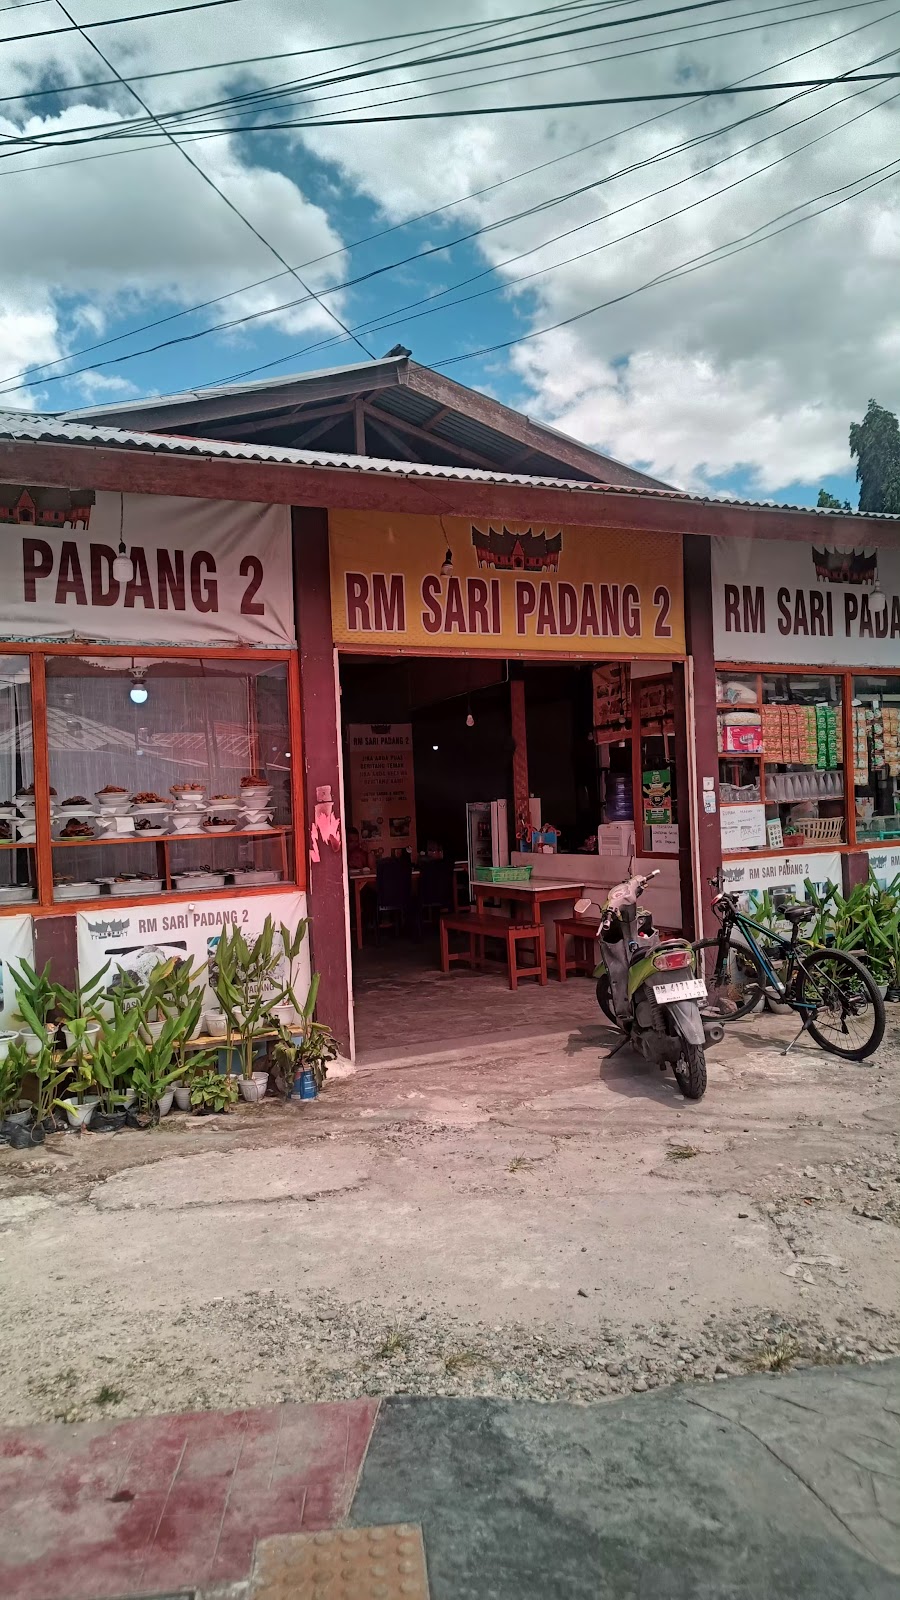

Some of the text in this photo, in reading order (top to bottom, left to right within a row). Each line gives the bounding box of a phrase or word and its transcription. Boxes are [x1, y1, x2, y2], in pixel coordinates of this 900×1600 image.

[22, 538, 265, 616] PADANG 2
[345, 572, 673, 638] RM SARI PADANG 2
[724, 584, 766, 634] RM
[777, 587, 834, 636] SARI
[365, 737, 379, 746] SARI
[381, 737, 404, 745] PADANG
[405, 737, 410, 745] 2
[749, 864, 809, 879] RM SARI PADANG 2
[138, 909, 249, 933] RM SARI PADANG 2
